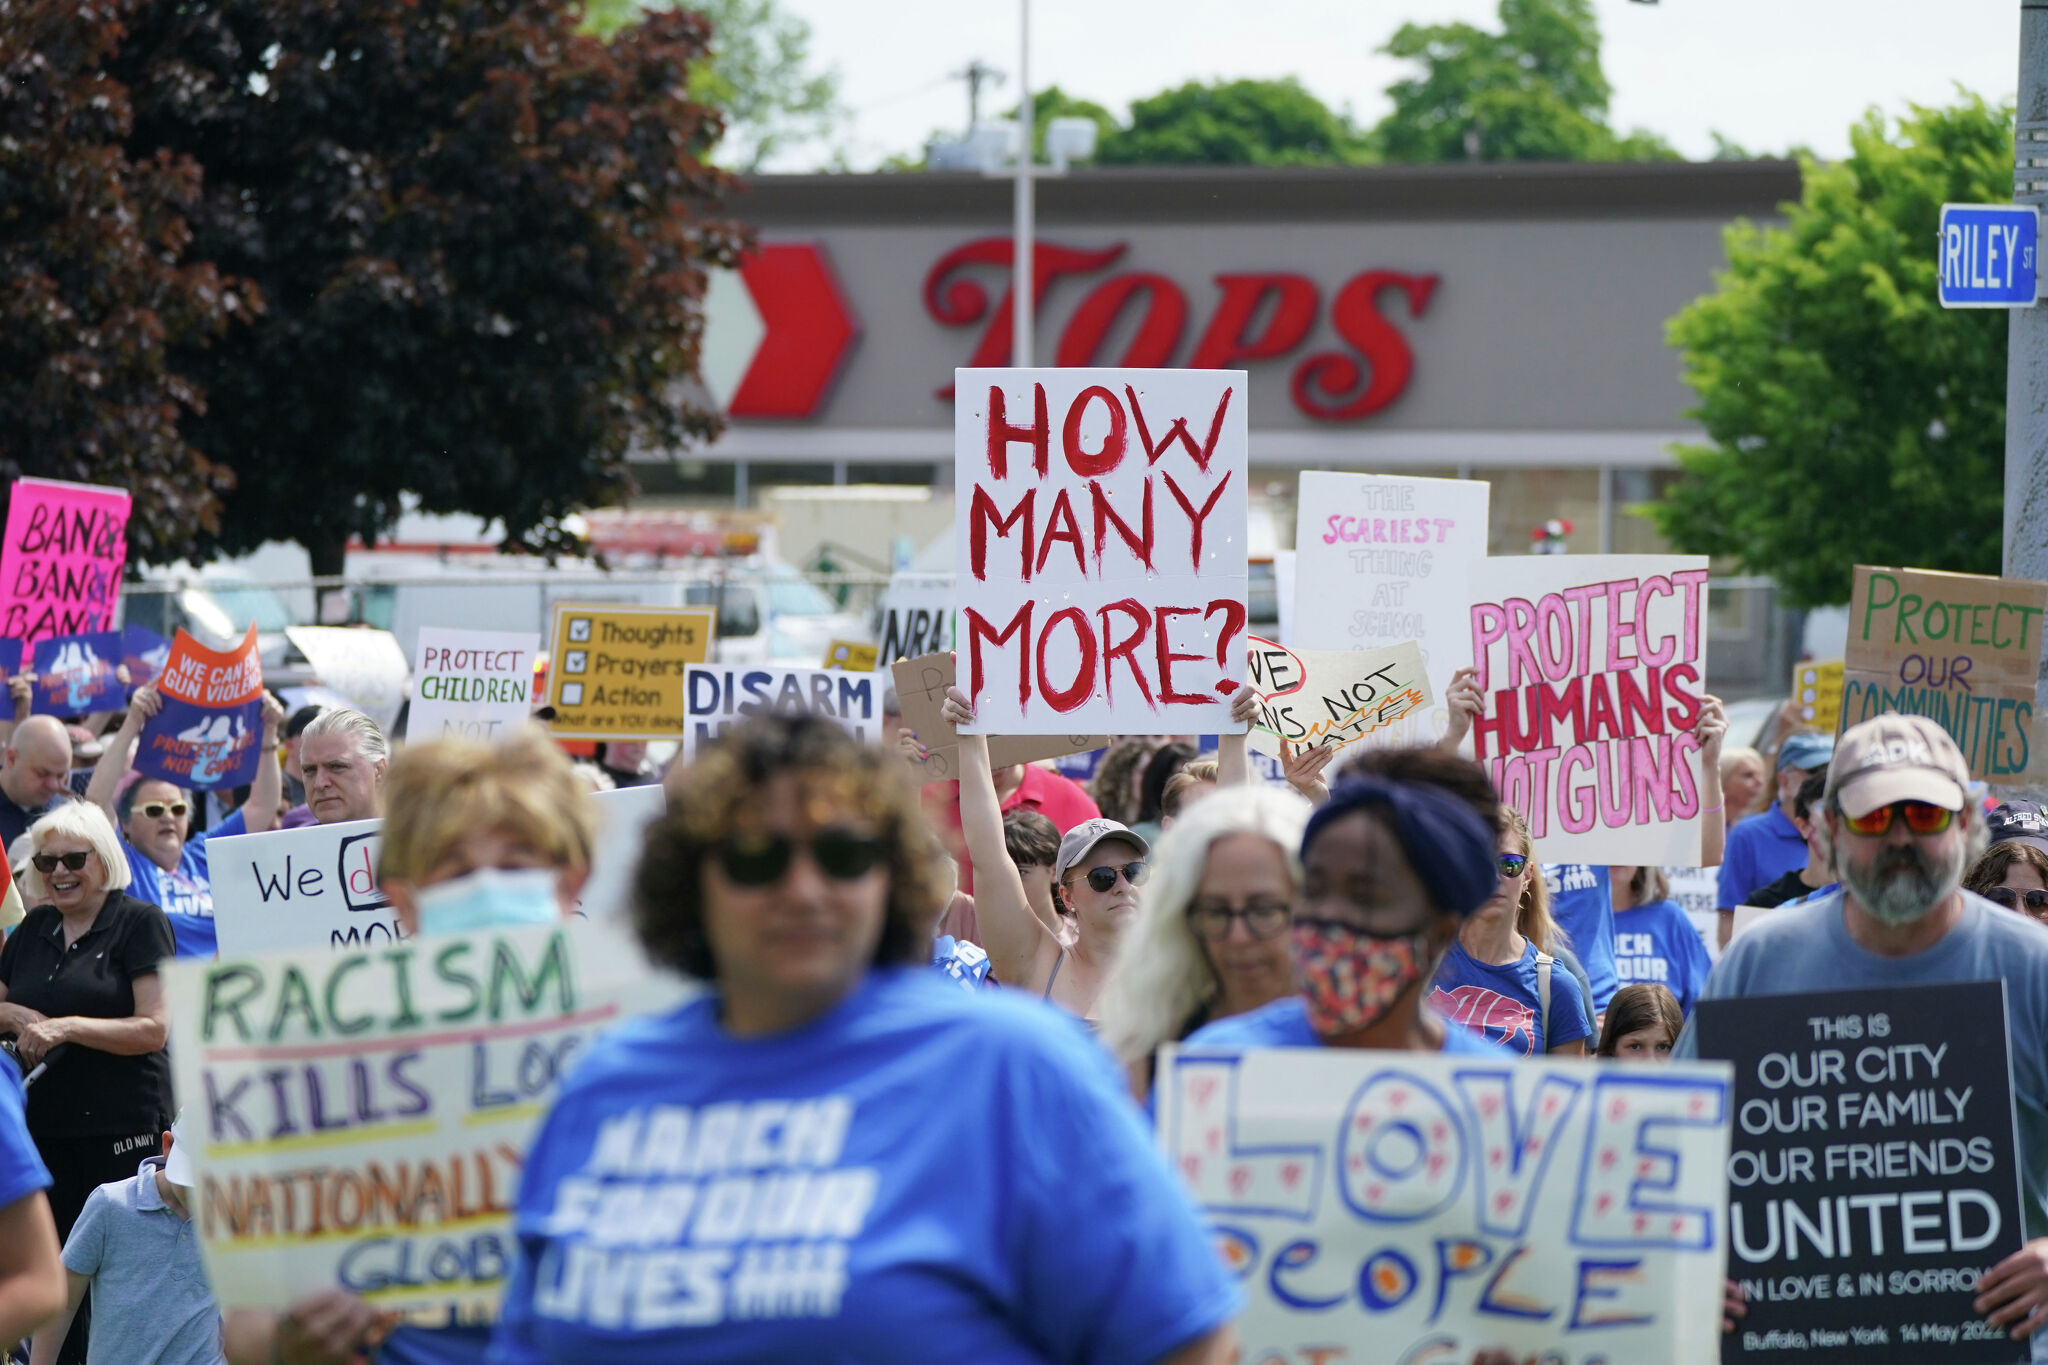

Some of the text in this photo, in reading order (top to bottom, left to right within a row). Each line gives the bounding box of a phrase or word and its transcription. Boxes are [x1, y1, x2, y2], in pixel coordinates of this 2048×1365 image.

[1945, 224, 2019, 289] RILEY
[986, 382, 1233, 480] HOW
[1362, 485, 1415, 512] THE
[969, 470, 1232, 583] MANY
[1323, 514, 1455, 545] SCARIEST
[1348, 549, 1433, 578] THING
[1371, 581, 1409, 608] AT
[1863, 573, 2043, 650] PROTECT
[601, 621, 694, 650] Thoughts
[881, 609, 943, 667] NRA
[1348, 610, 1425, 638] SCHOOL
[1471, 569, 1709, 692] PROTECT
[424, 647, 525, 672] PROTECT
[595, 651, 684, 680] Prayers
[963, 597, 1246, 717] MORE?
[1900, 654, 1973, 692] OUR
[164, 667, 202, 699] GUN
[421, 676, 527, 703] CHILDREN
[591, 685, 662, 707] Action
[688, 670, 873, 720] DISARM
[1322, 662, 1399, 722] NOT
[1473, 663, 1702, 760] HUMANS
[1557, 732, 1702, 834] GUNS
[252, 855, 324, 902] We
[202, 930, 577, 1042] RACISM
[1808, 1012, 1892, 1041] THIS IS
[1758, 1042, 1948, 1090] OUR CITY
[203, 1050, 435, 1144] KILLS
[1739, 1085, 1973, 1135] OUR FAMILY
[114, 1133, 154, 1155] OLD NAVY
[1171, 1055, 1729, 1253] LOVE
[1727, 1136, 1996, 1187] OUR FRIENDS
[1730, 1188, 2002, 1263] UNITED
[1767, 1273, 1832, 1302] LOVE
[1836, 1272, 1856, 1298] &
[1859, 1270, 1884, 1297] IN
